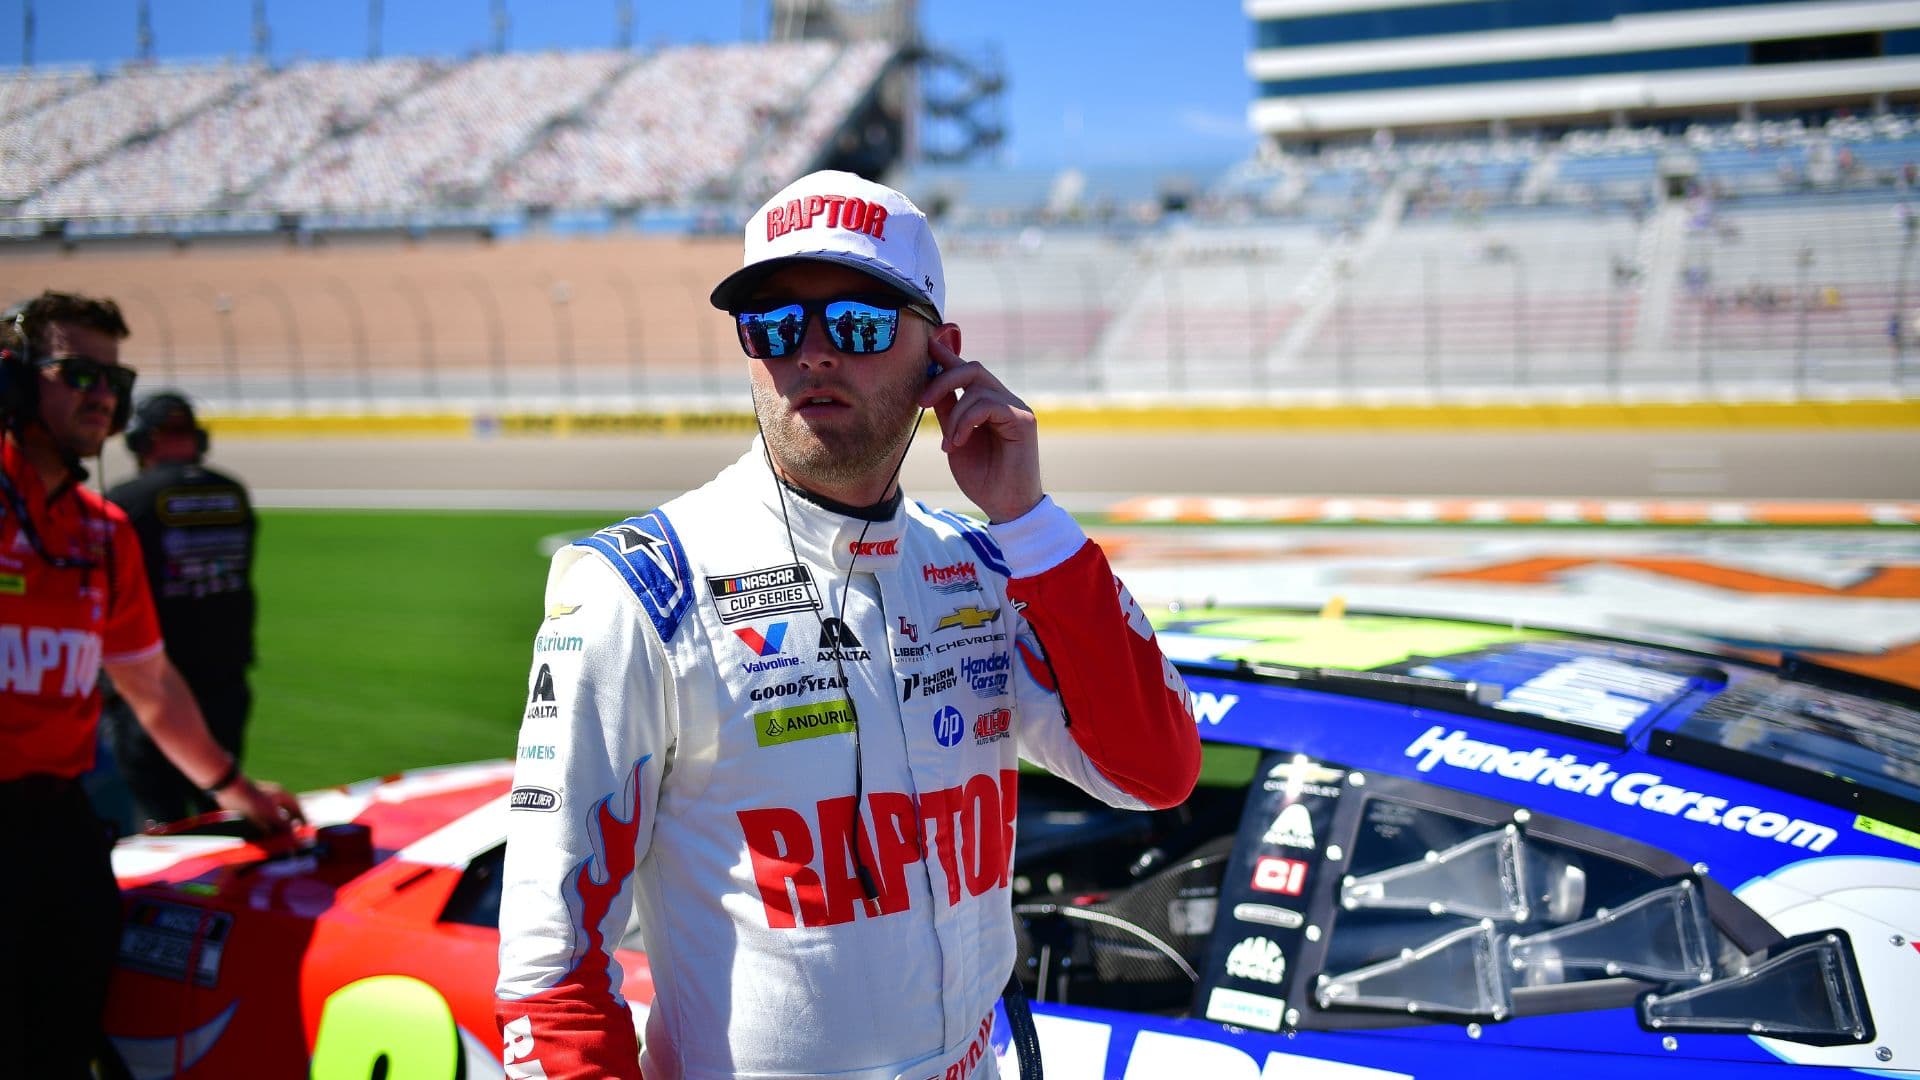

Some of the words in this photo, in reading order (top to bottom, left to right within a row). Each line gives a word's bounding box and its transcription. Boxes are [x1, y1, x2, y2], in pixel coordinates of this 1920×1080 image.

[766, 194, 888, 242] RAPTOR
[741, 569, 795, 593] NASCAR
[730, 595, 757, 611] CUP
[758, 587, 803, 606] SERIES
[894, 642, 932, 657] LIBERTY
[935, 633, 1008, 654] CHEVROET
[742, 656, 800, 674] Valvoline
[816, 650, 872, 662] AXALTA
[749, 674, 850, 702] GOODYEAR
[923, 676, 958, 697] ENERGY
[786, 709, 854, 732] ANDURIL
[736, 769, 1018, 929] RAPTOR
